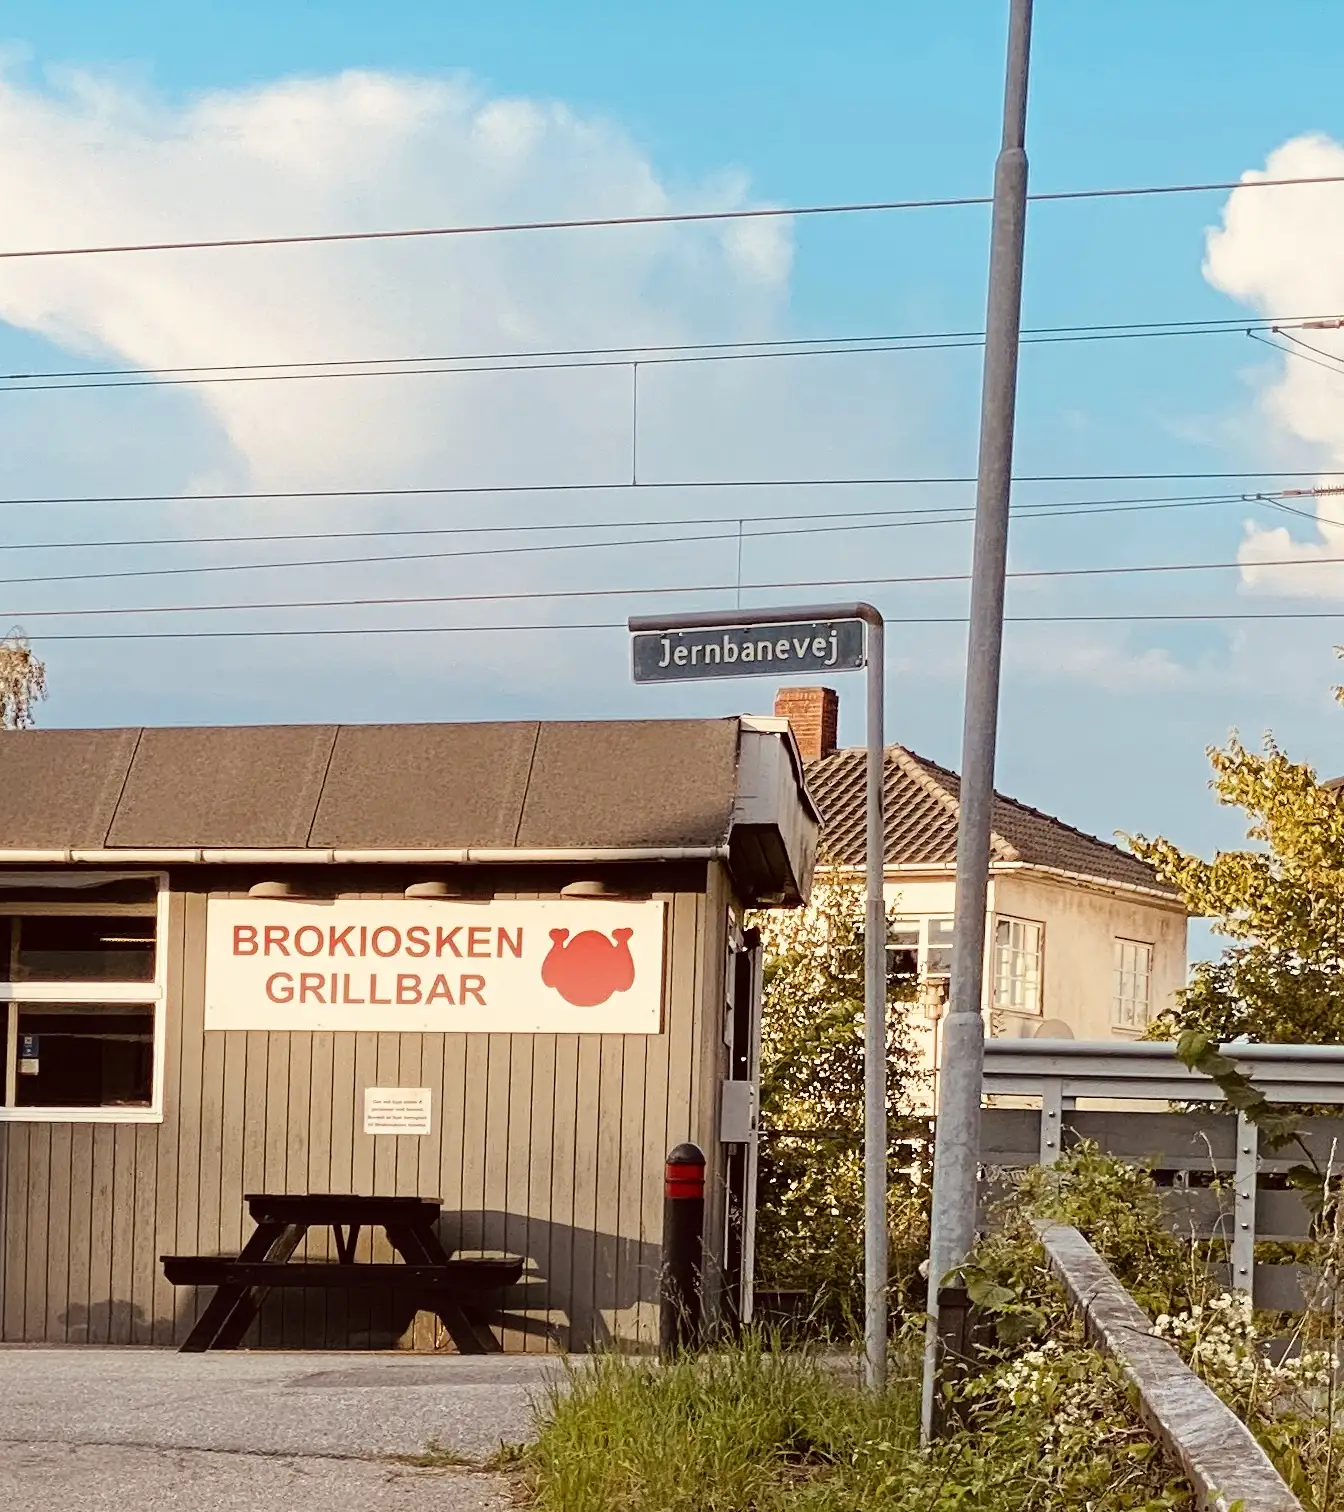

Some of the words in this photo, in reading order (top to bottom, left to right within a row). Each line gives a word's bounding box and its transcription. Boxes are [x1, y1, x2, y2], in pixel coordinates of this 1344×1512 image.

[658, 629, 838, 668] Jernbanevej
[232, 925, 523, 958] BROKIOSKEN
[265, 972, 488, 1005] GRILLBAR
